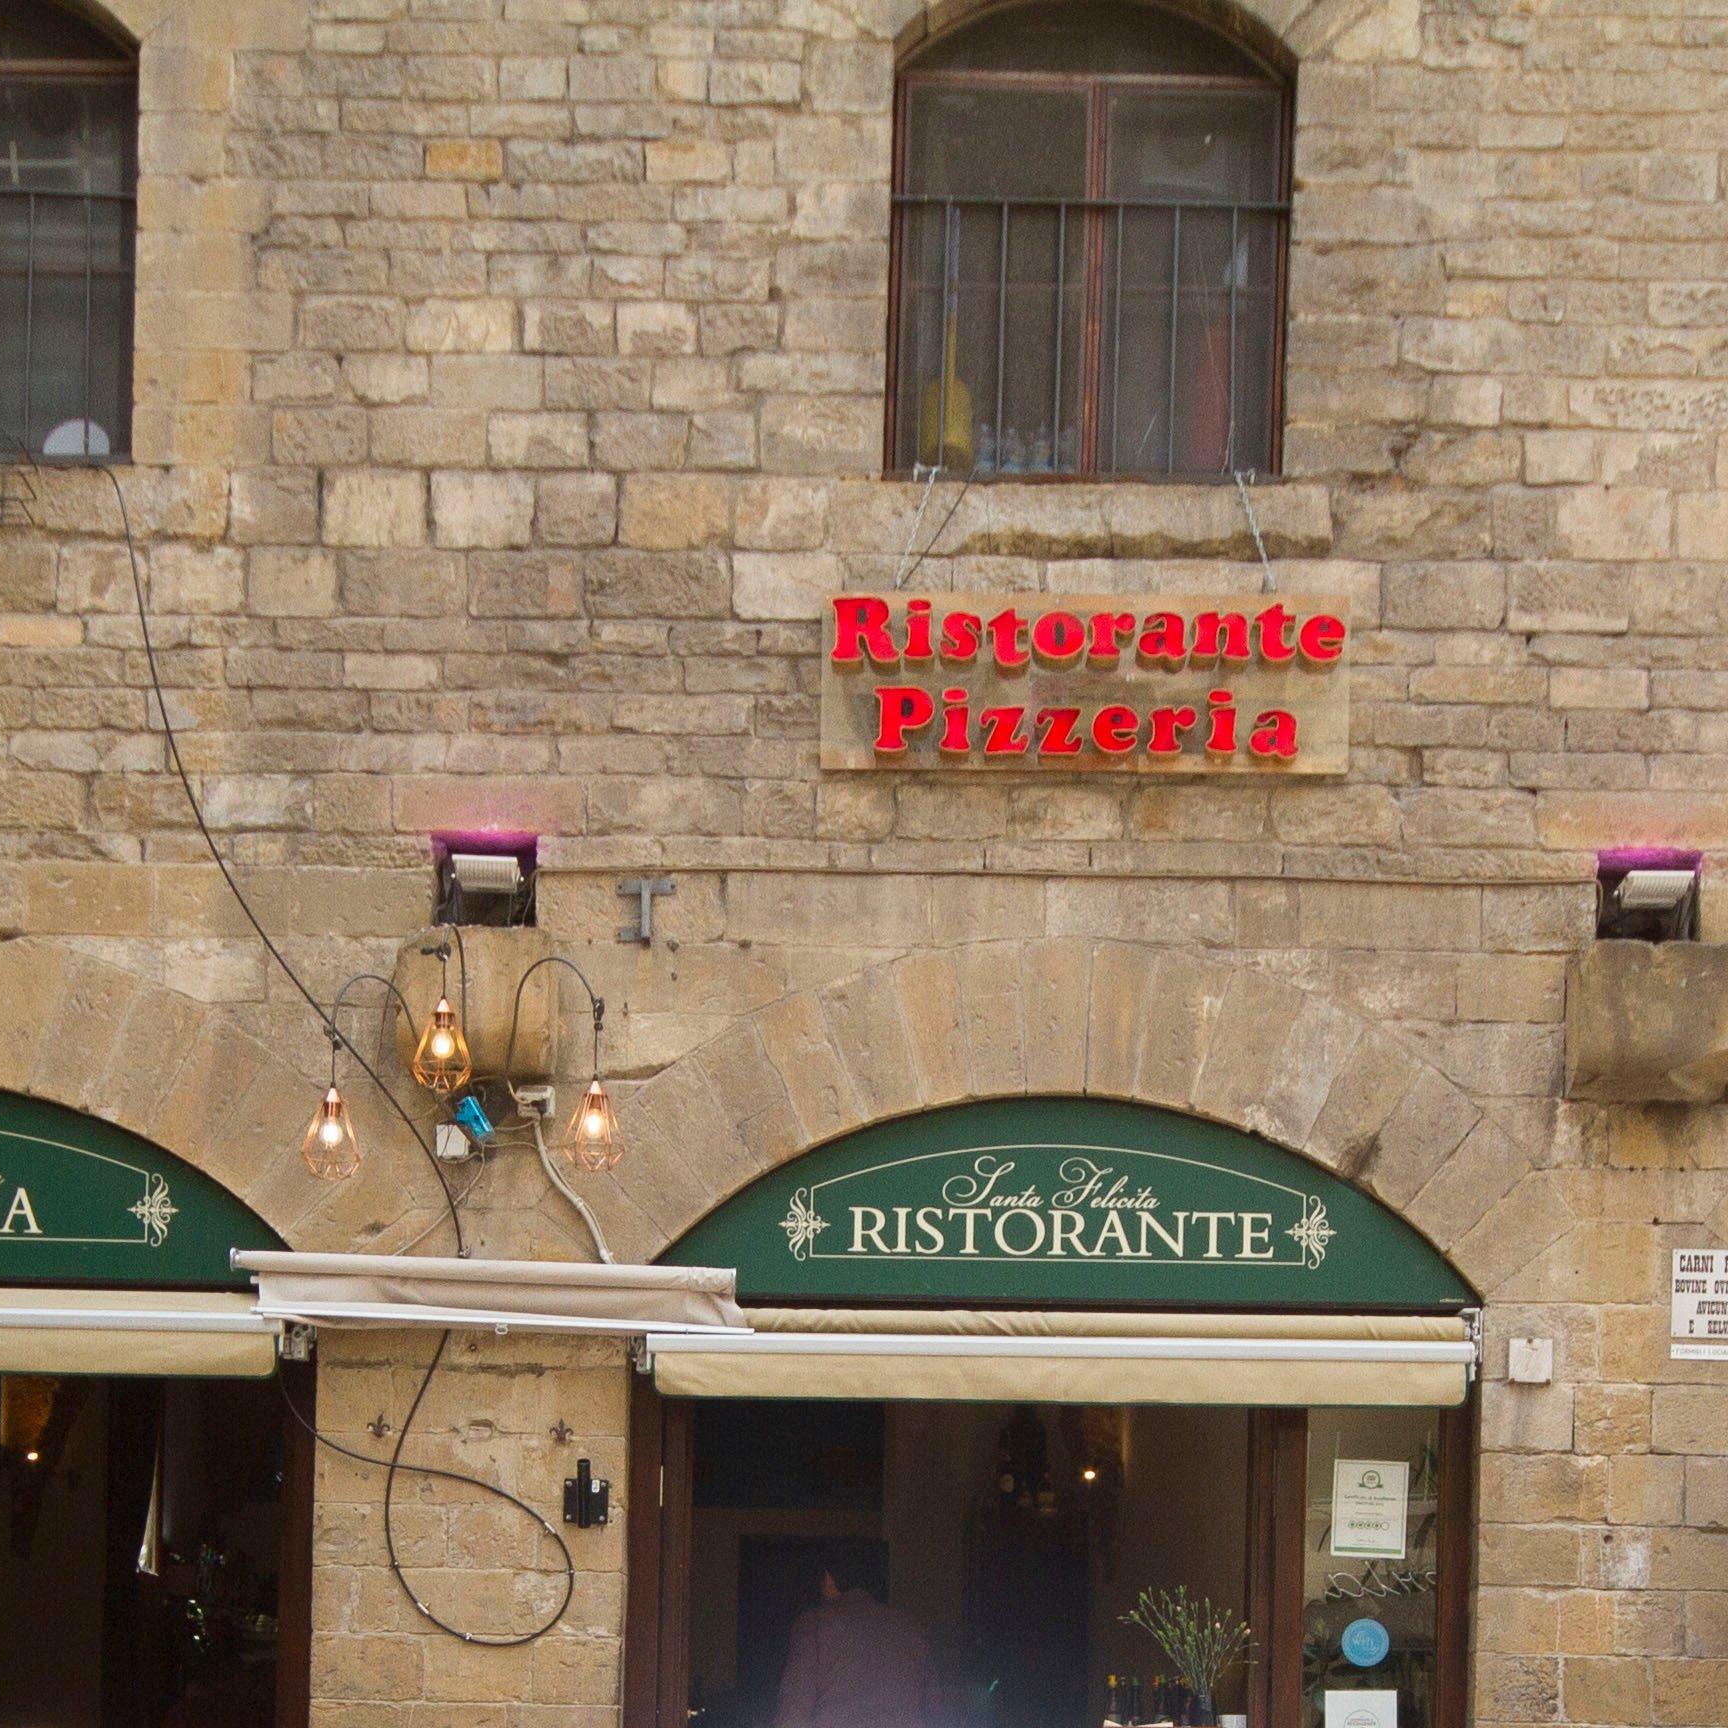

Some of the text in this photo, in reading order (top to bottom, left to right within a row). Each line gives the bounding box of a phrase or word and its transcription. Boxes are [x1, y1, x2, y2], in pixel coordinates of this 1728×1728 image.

[831, 597, 1347, 669] Ristorante
[873, 686, 1300, 761] Pizzeria
[943, 1156, 1160, 1210] Santa Felicita
[847, 1206, 1274, 1259] RISTORANTE
[1675, 1279, 1707, 1294] BOVINE
[1679, 1254, 1714, 1273] CARNI
[1688, 1319, 1694, 1334] E
